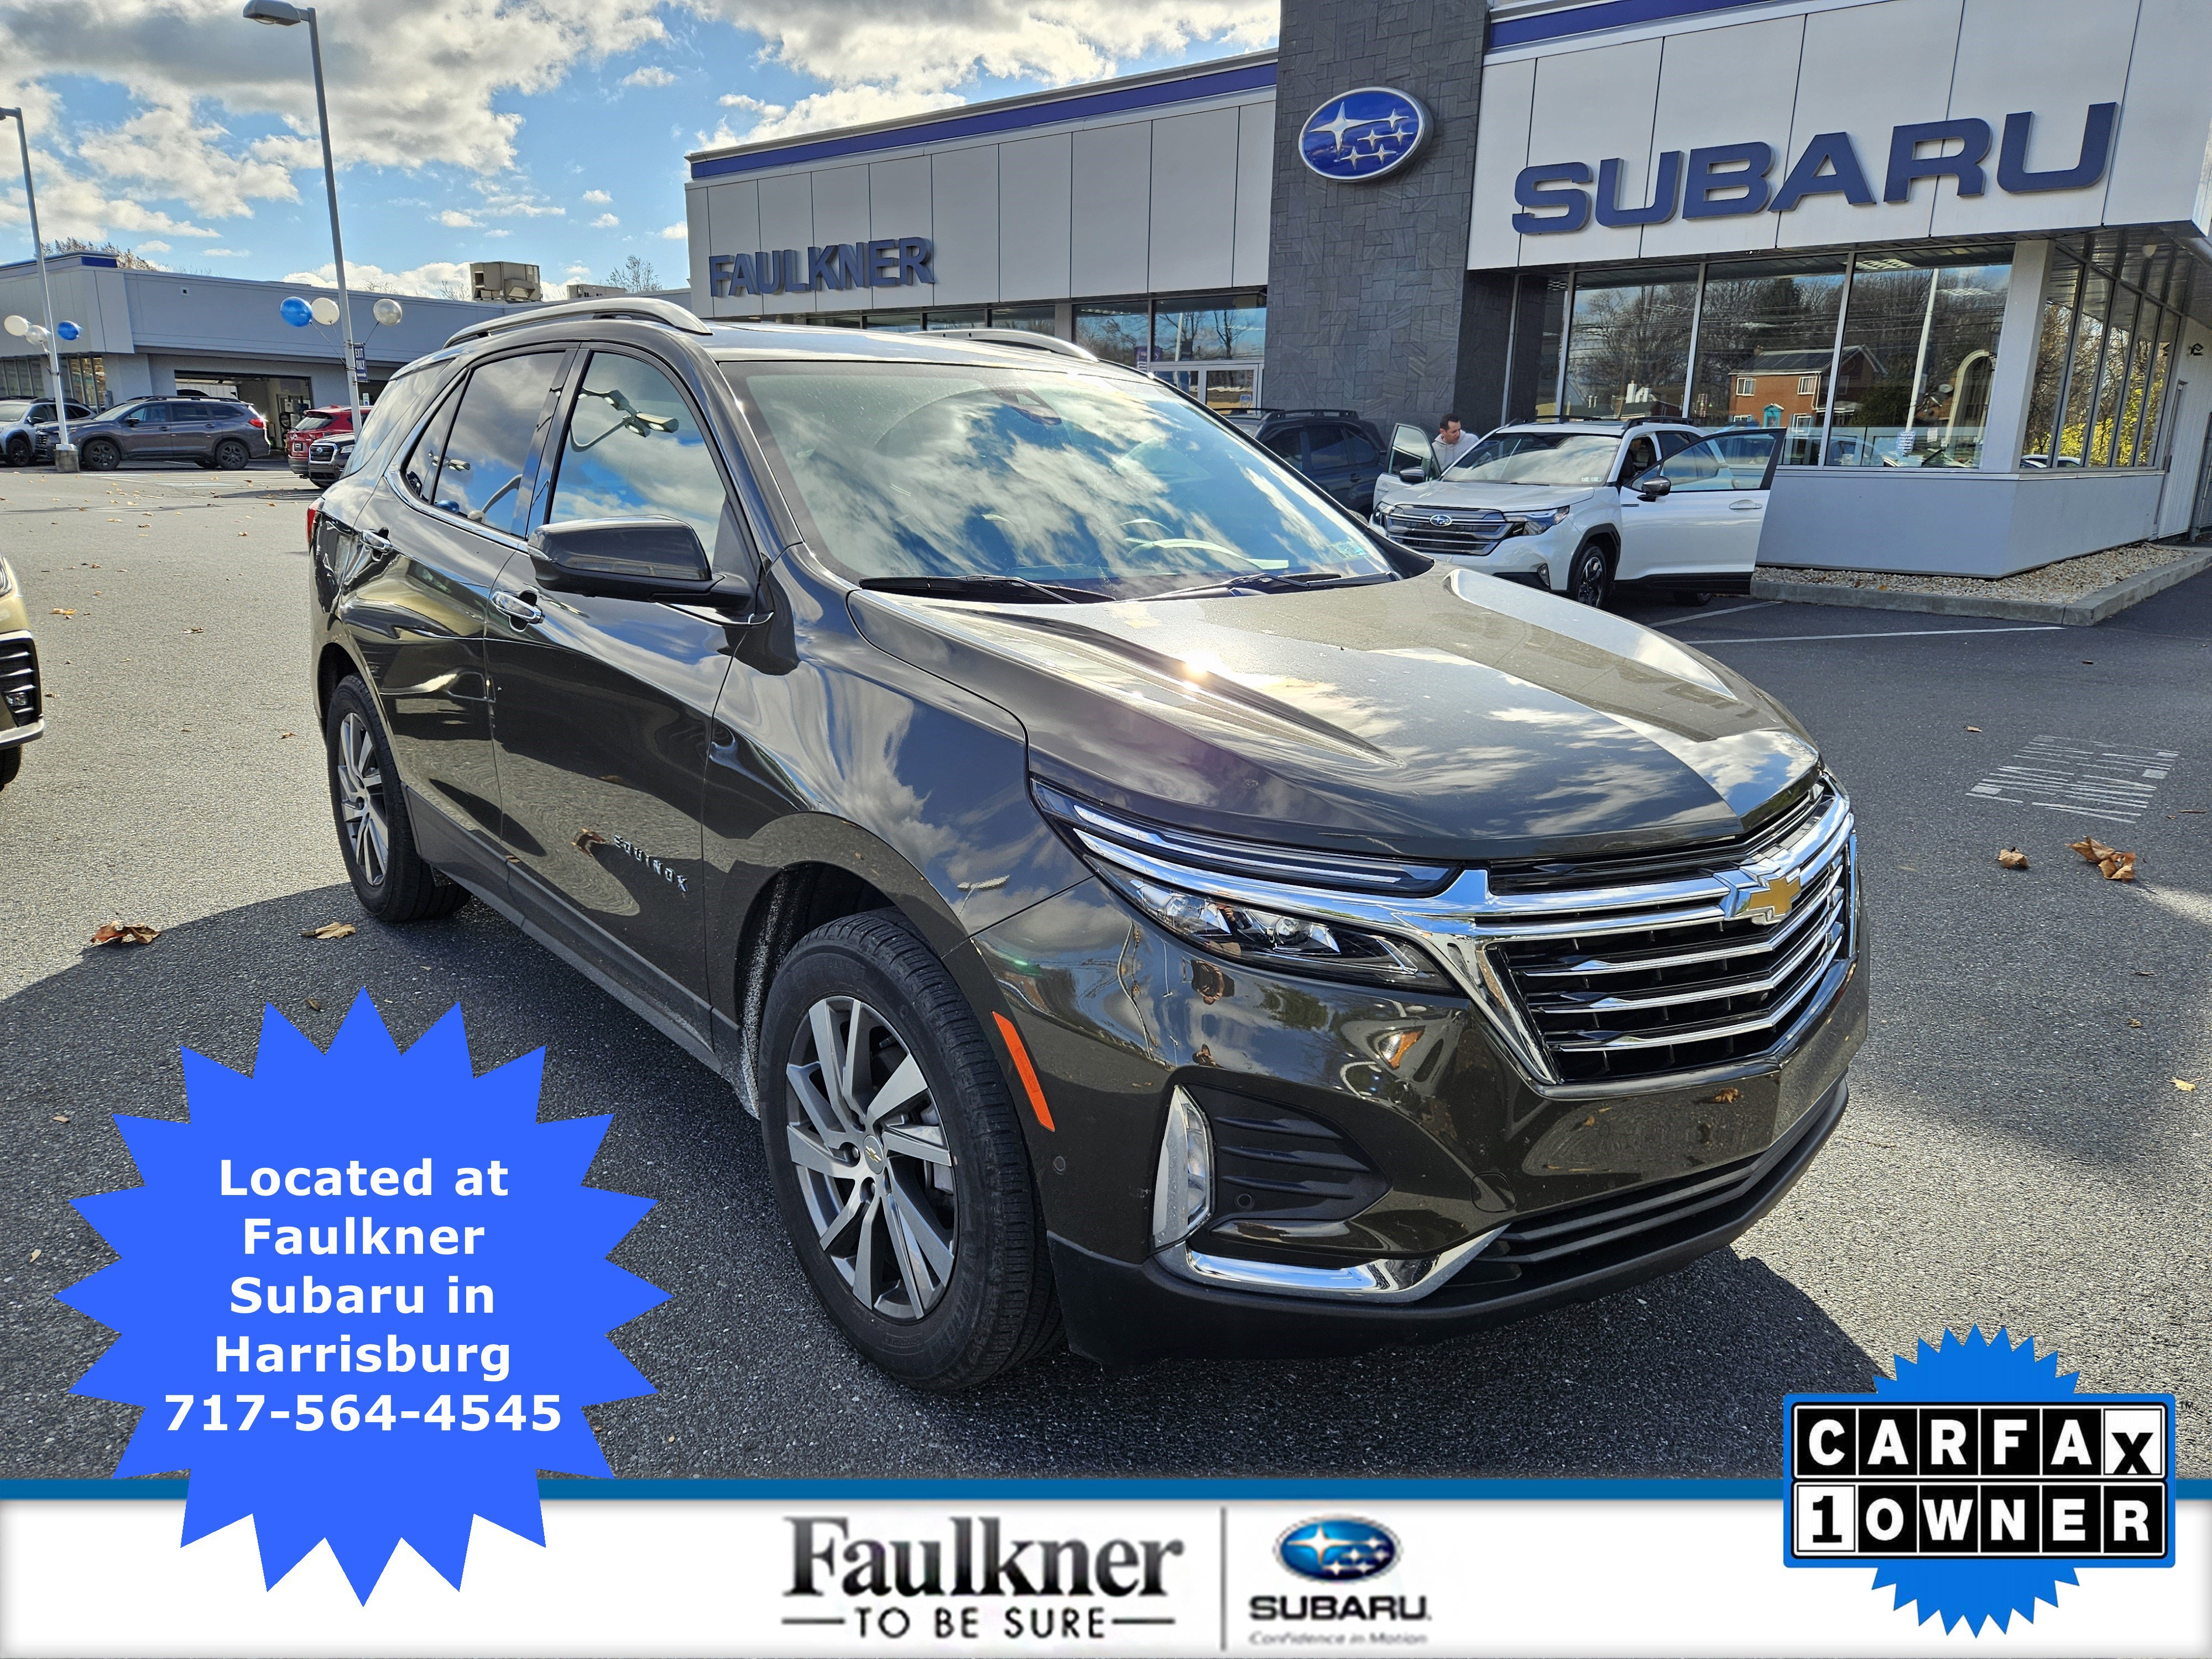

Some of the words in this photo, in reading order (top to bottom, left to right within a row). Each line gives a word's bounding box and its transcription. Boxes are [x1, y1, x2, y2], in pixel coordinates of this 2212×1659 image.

[1512, 102, 2119, 234] SUBARU
[709, 237, 935, 297] FAULKNER
[614, 834, 687, 892] EQUINOX
